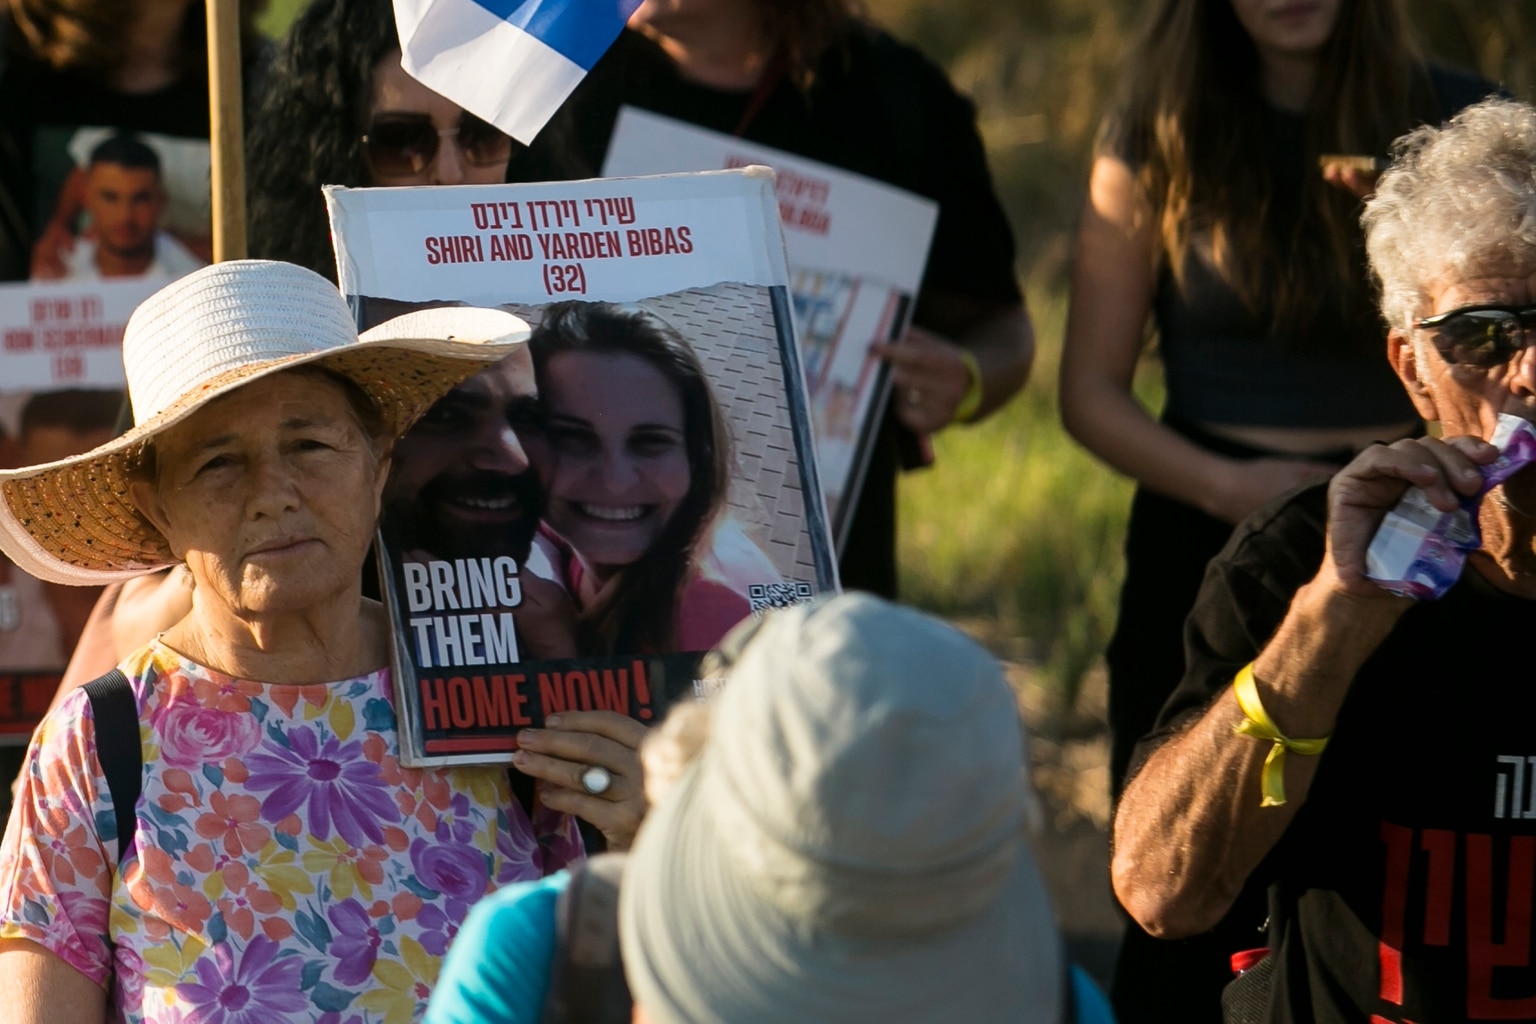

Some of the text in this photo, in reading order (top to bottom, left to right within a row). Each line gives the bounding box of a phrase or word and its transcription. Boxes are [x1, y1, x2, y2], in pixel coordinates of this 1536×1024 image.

[470, 197, 636, 231] שירי וירדן ביבס
[425, 226, 694, 265] SHIRI AND YARDEN BIBAS
[543, 262, 587, 295] (32)
[403, 556, 523, 612] BRING
[409, 612, 520, 668] THEM
[420, 660, 654, 731] HOME NOW!
